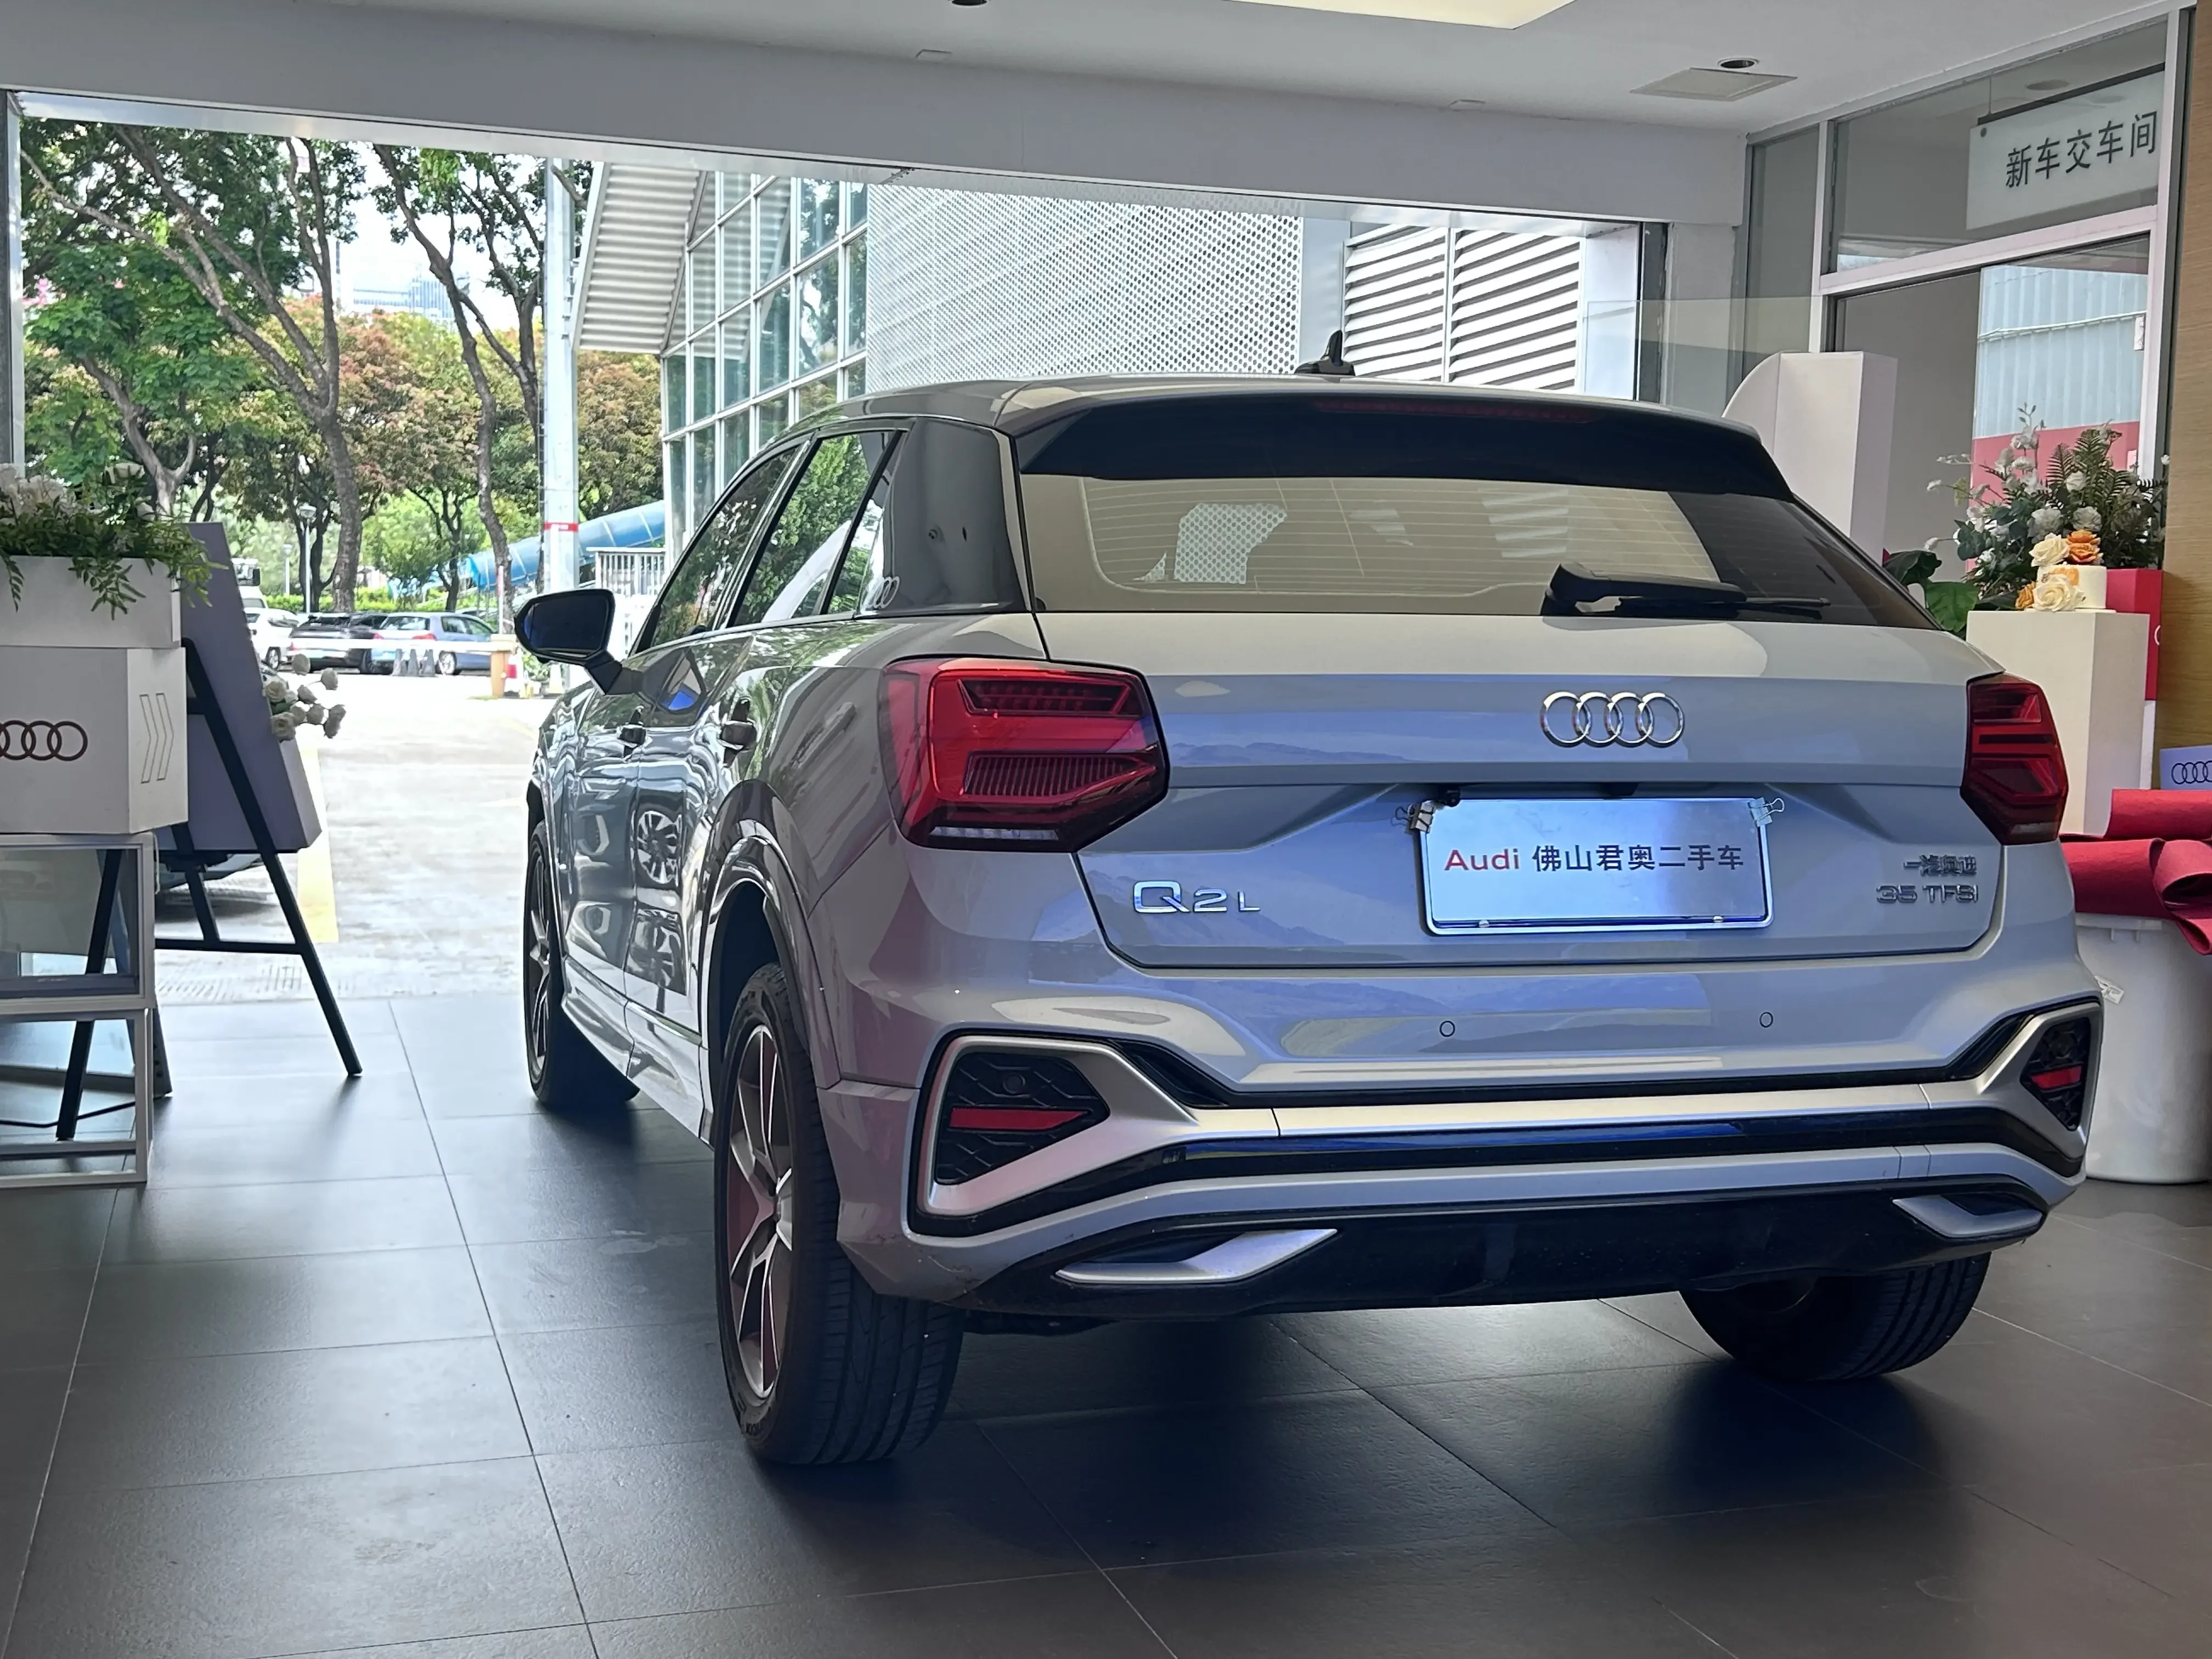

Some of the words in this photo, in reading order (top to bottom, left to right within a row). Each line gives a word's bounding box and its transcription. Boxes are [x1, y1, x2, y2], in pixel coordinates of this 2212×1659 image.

[2005, 111, 2157, 188] 新车交车间
[1444, 849, 1520, 871] Audi
[1532, 845, 1744, 872] 佛山君奥二手车
[1876, 884, 1917, 903] 35
[1922, 884, 1978, 903] TFSI
